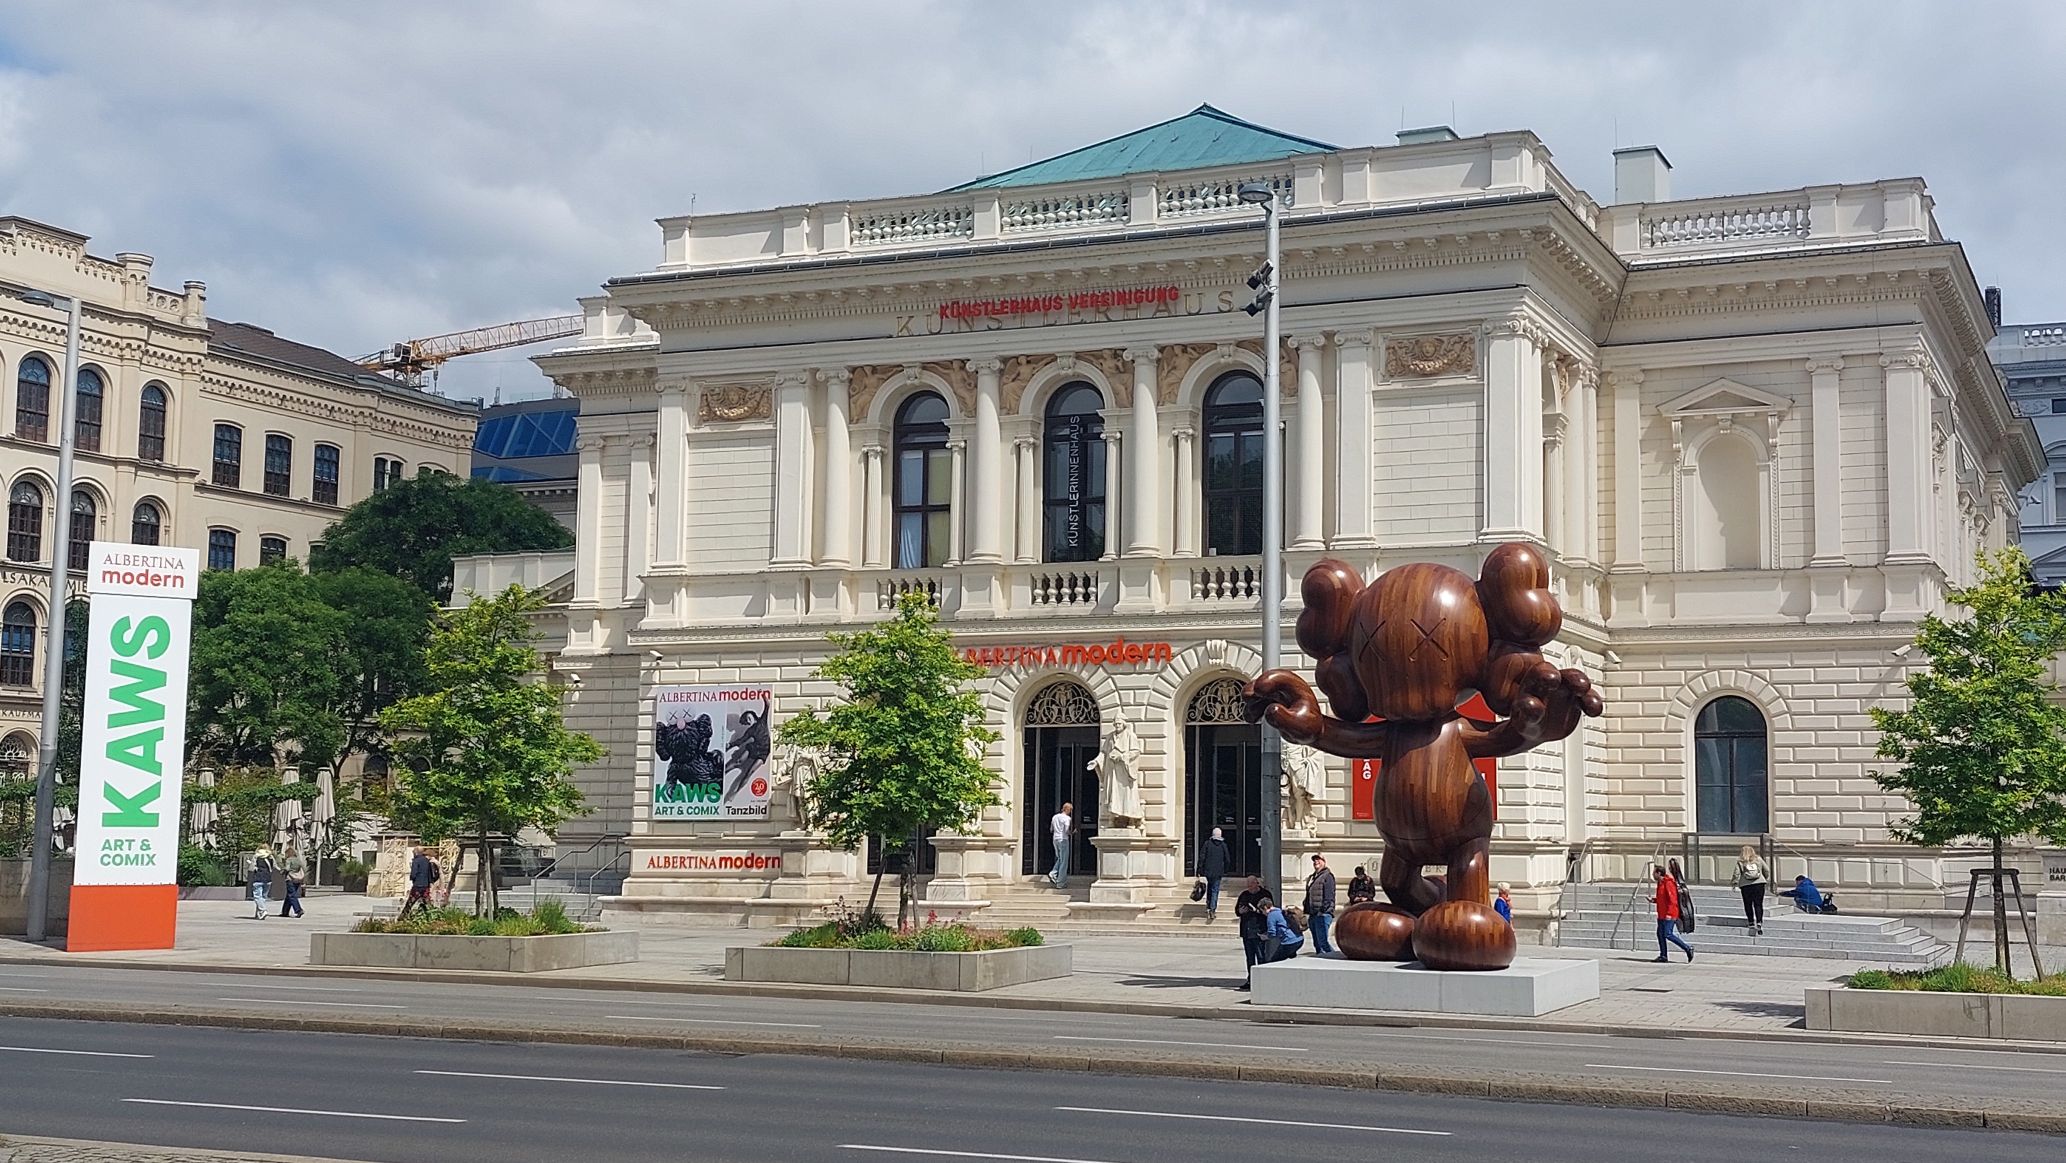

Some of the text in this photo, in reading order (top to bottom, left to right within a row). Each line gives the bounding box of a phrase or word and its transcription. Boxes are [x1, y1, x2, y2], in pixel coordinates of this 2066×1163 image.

[939, 286, 1180, 319] KÜNSTLERHAUS VEREINIGUNG
[1067, 415, 1080, 547] KÜNSTLERINNENHAUS
[103, 553, 184, 570] ALBERTINA
[102, 569, 184, 588] modern
[955, 635, 1173, 667] BERTINA modern
[660, 688, 770, 703] ALBERTINA modern
[101, 615, 171, 827] KAWS
[655, 783, 721, 803] KAWS
[655, 806, 720, 816] ART & COMIX
[726, 805, 768, 816] Tanzbild
[101, 839, 152, 852] ART &
[100, 854, 156, 867] COMIX
[647, 853, 781, 870] ALBERTINA modern
